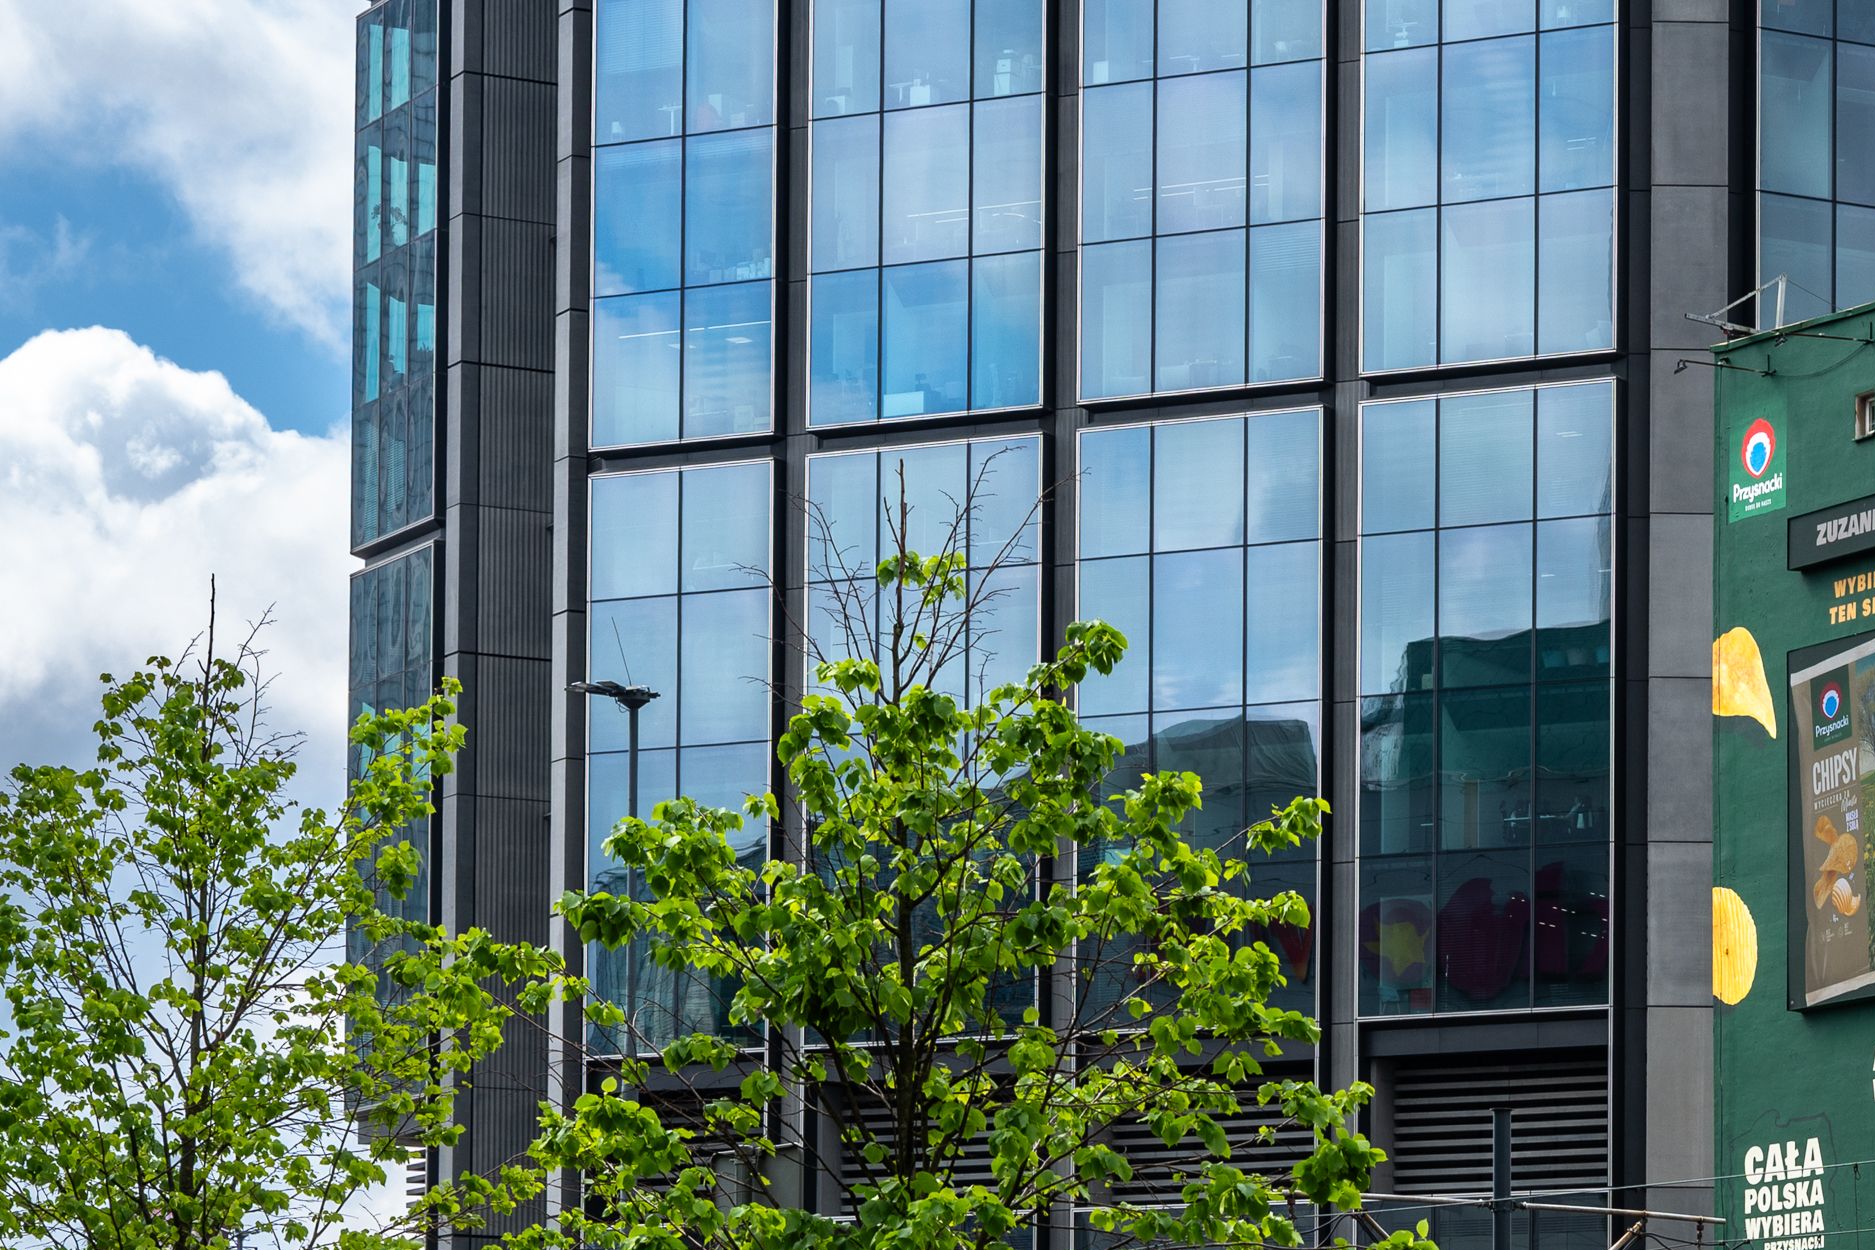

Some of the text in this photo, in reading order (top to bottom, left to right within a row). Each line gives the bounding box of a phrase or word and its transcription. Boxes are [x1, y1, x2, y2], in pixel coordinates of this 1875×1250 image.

[1733, 472, 1783, 503] Przysnacki
[1829, 601, 1857, 625] TEN
[1815, 714, 1849, 737] Przysnacki
[1813, 747, 1857, 795] CHIPSY
[1744, 1137, 1824, 1185] CAŁA
[1744, 1179, 1825, 1214] POLSKA
[1744, 1209, 1825, 1241] WYBIERA
